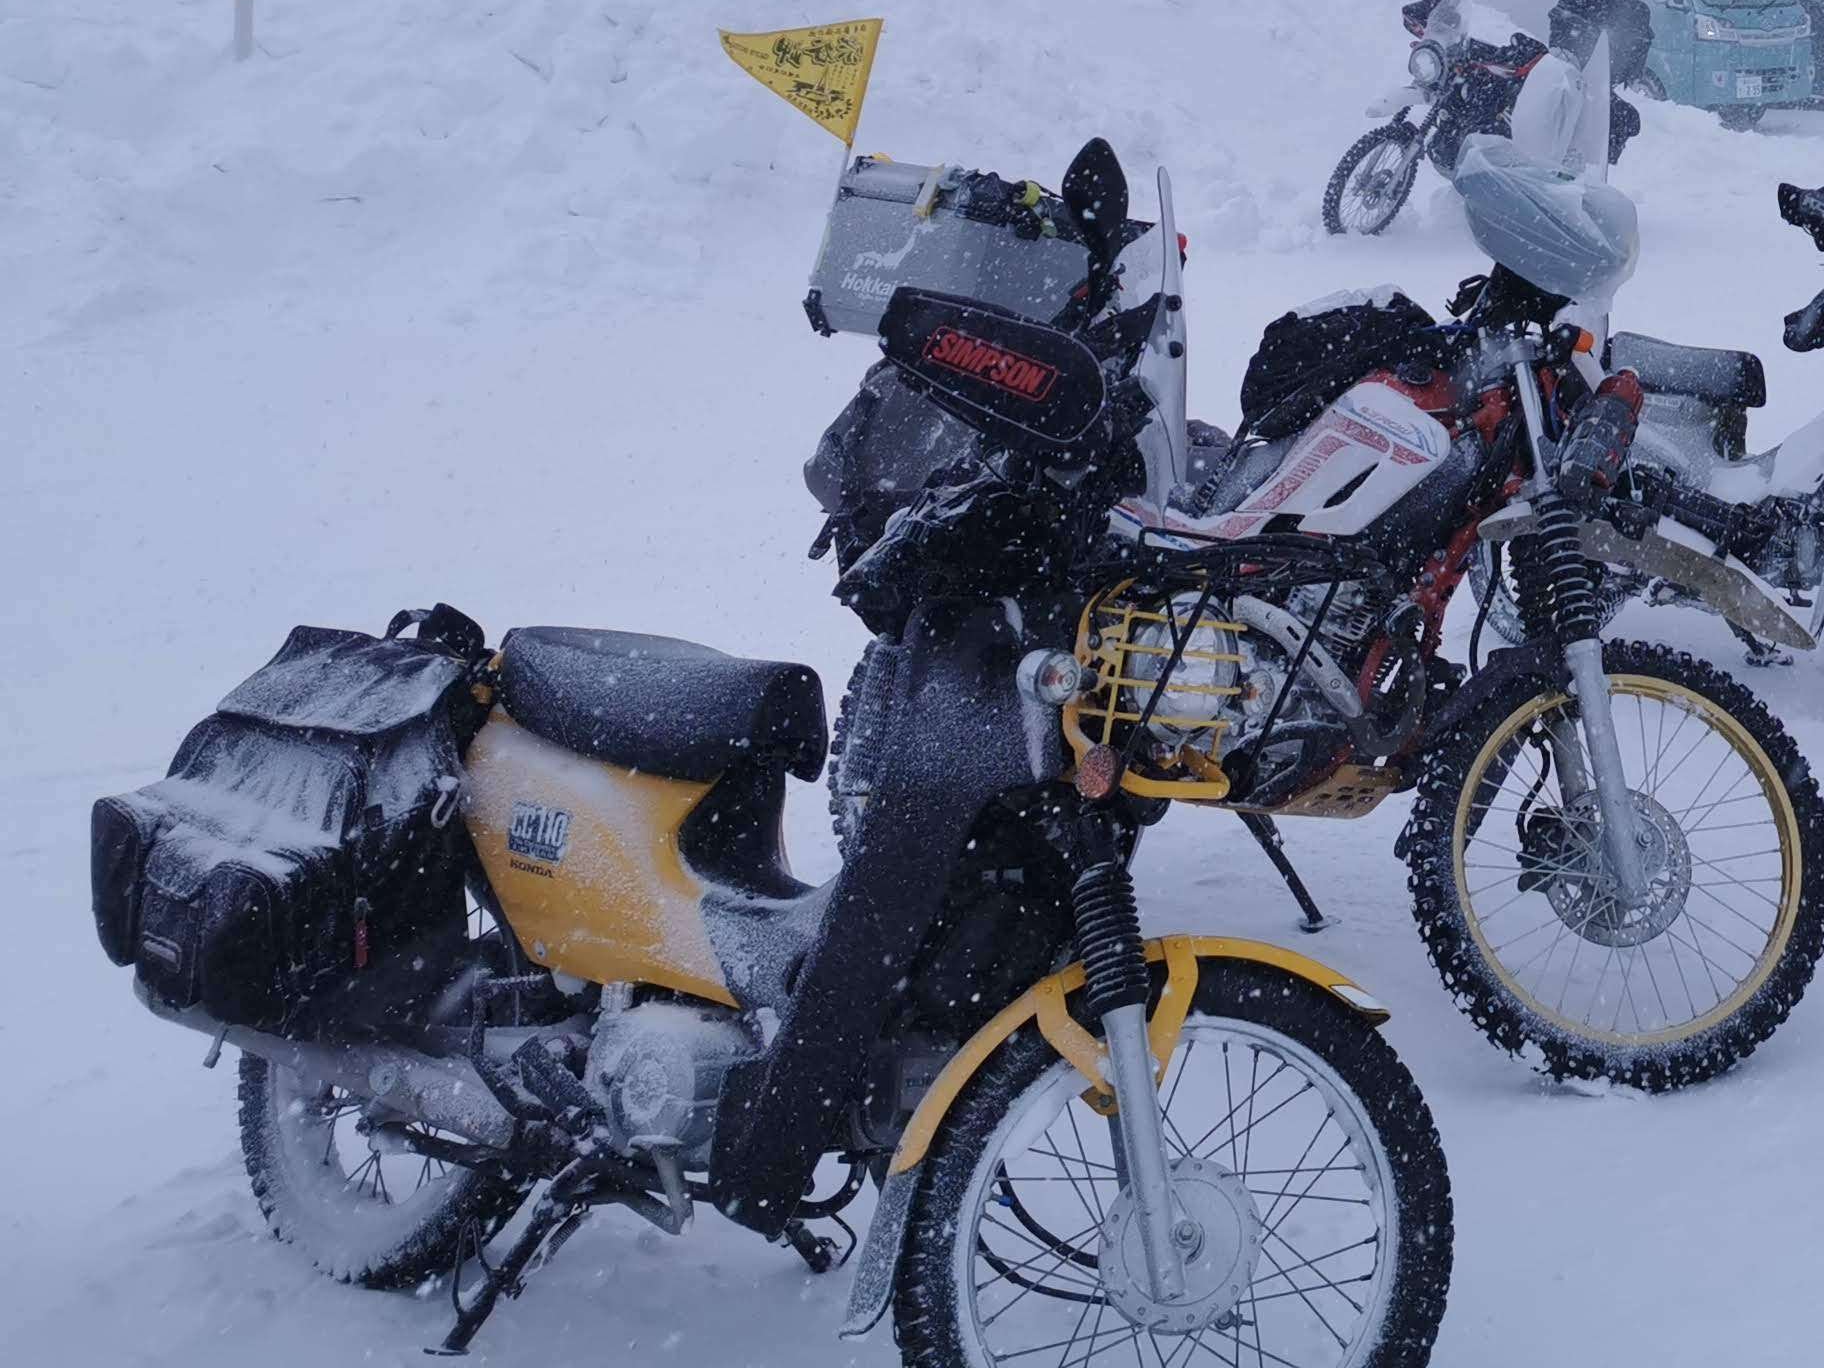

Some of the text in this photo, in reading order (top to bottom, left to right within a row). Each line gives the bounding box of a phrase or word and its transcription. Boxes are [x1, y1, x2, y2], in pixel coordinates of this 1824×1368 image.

[841, 272, 897, 296] Hokkai
[932, 333, 1047, 394] SIMPSON
[510, 859, 554, 878] HONDA
